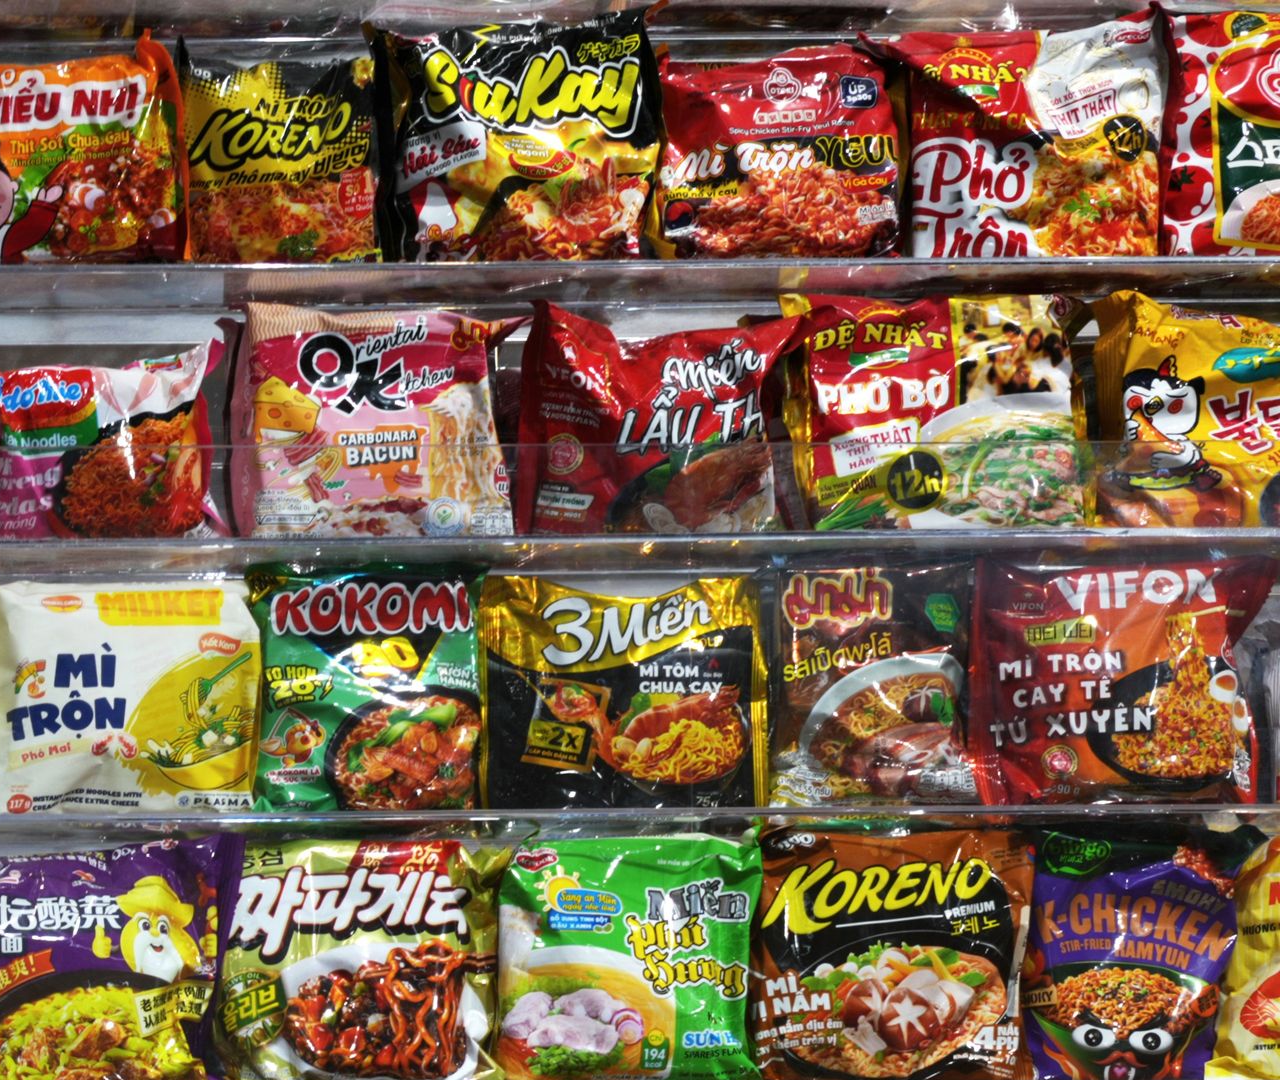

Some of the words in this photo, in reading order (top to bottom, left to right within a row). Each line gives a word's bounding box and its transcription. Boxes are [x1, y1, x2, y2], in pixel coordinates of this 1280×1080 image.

[74, 84, 139, 123] NHỊ
[729, 128, 750, 136] Spicy
[753, 127, 779, 135] Chicken
[739, 143, 812, 177] Trộn
[914, 143, 1034, 202] Phở
[815, 323, 854, 349] ĐỆ
[862, 318, 945, 349] NHẤT
[818, 375, 889, 412] PHỞ
[900, 375, 950, 409] BÒ
[339, 431, 417, 443] CARBONARA
[347, 447, 414, 465] BACUN
[97, 590, 223, 618] MILIKET
[1055, 571, 1219, 608] VIFON
[275, 585, 471, 634] KOKOMI
[542, 596, 594, 665] 3
[54, 643, 116, 688] MÌ
[640, 664, 657, 680] MÌ
[662, 665, 698, 679] TÔM
[1000, 655, 1031, 681] MÌ
[640, 680, 684, 694] CHUA
[689, 681, 722, 695] CAY
[1013, 686, 1070, 708] CAY
[7, 692, 126, 740] TRỘN
[1048, 707, 1154, 735] XUYÊN
[763, 859, 989, 932] KORENO
[1114, 943, 1190, 969] RAMYUN
[774, 992, 830, 1015] NẤM
